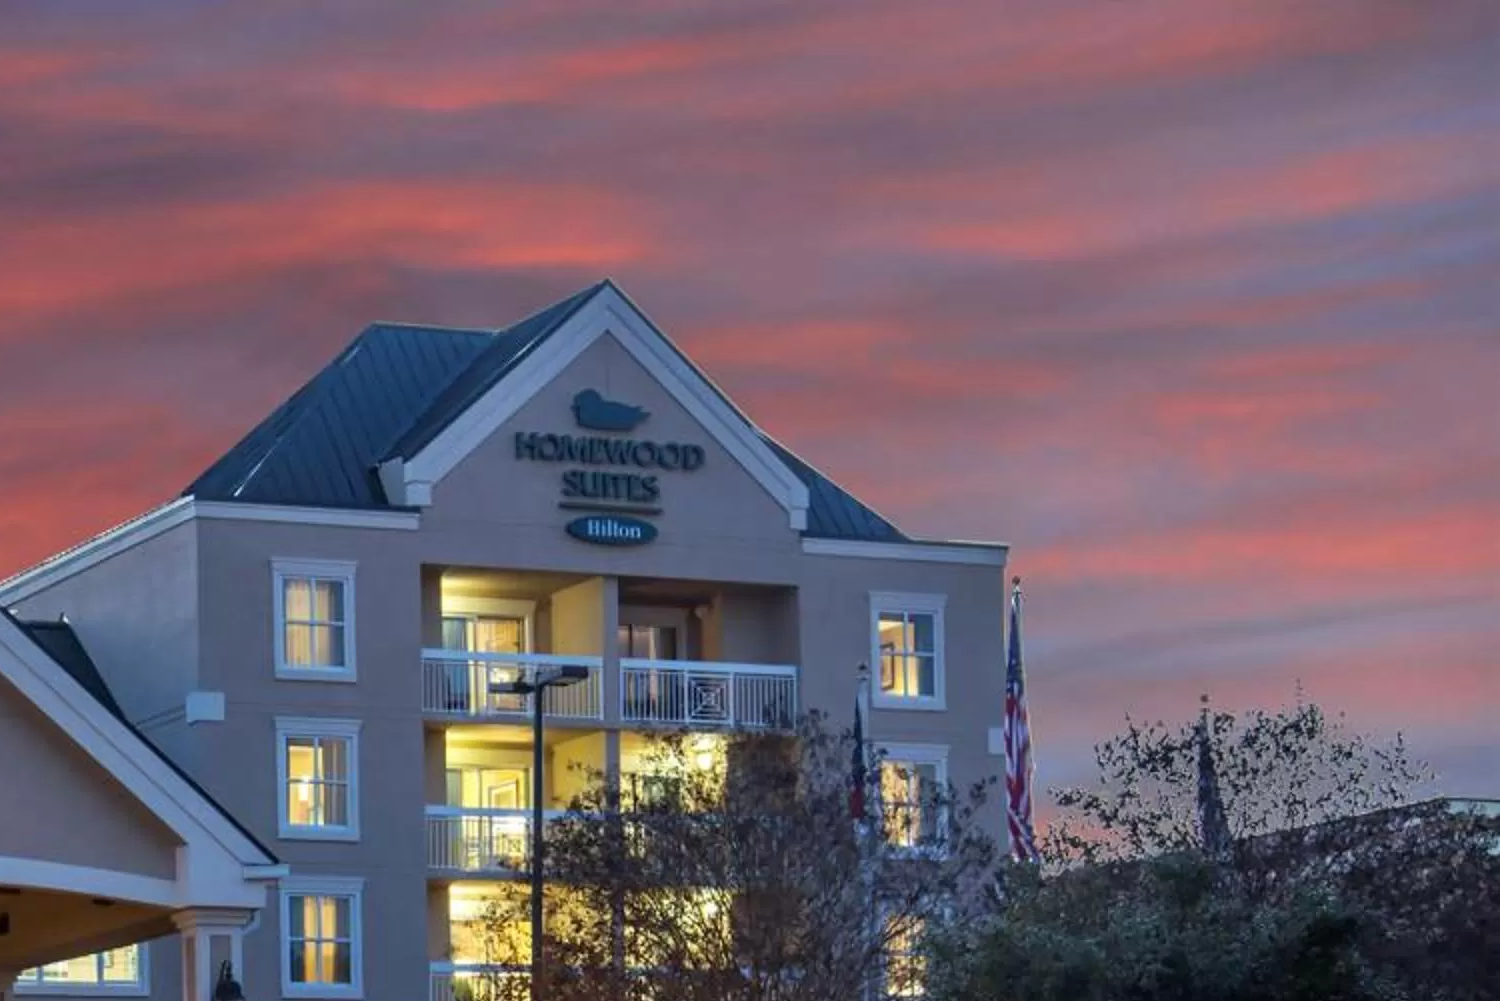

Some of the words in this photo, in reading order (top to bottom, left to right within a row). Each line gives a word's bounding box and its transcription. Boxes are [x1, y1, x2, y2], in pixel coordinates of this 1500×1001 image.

[514, 431, 706, 471] HOMEWOOD
[561, 470, 660, 502] SUITES
[587, 519, 641, 539] Hilton
